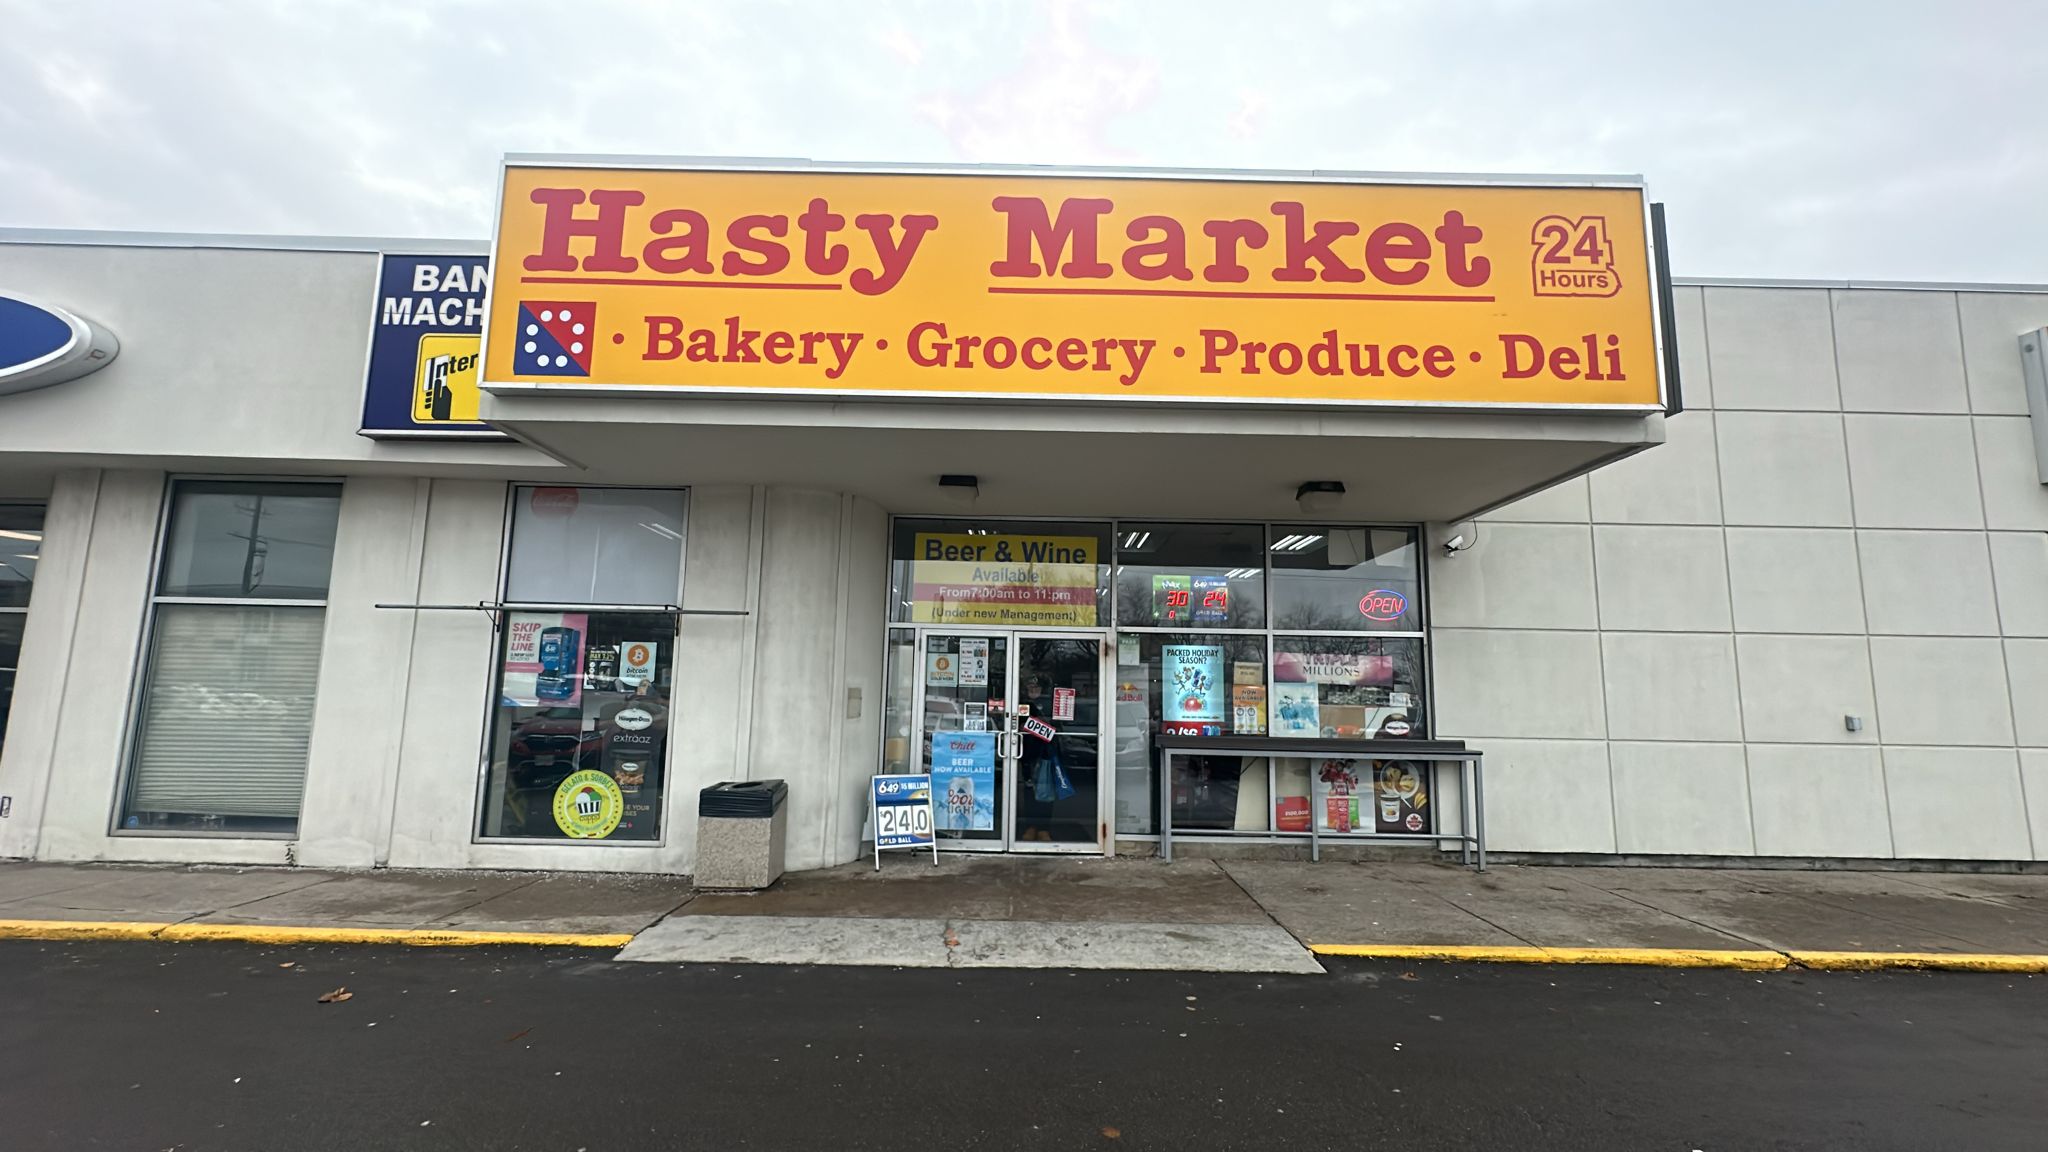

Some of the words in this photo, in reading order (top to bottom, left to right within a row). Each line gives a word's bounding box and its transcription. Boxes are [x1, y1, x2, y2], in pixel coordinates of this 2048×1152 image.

[523, 188, 938, 295] Hasty
[990, 197, 1491, 288] Market
[1541, 225, 1604, 264] 24
[1540, 269, 1609, 289] Hours
[642, 316, 863, 379] Bakery
[907, 321, 1156, 385] Grocery
[1199, 329, 1455, 378] Produce
[1499, 334, 1626, 381] Deli
[925, 539, 987, 561] Beer
[995, 541, 1012, 562] &
[1021, 541, 1087, 564] Wine
[972, 567, 1039, 583] Available
[1018, 588, 1031, 600] to
[1034, 588, 1071, 602] 11:pm
[1167, 590, 1188, 607] 30
[1203, 590, 1227, 607] 24
[1362, 597, 1403, 613] OPEN
[932, 607, 971, 619] (Under
[973, 610, 998, 618] new
[1000, 609, 1078, 622] Management)
[512, 622, 542, 633] SKIP
[512, 633, 533, 642] THE
[511, 643, 535, 652] LINE
[1166, 649, 1190, 657] PACKED
[1191, 649, 1219, 657] HOLIDAY
[1178, 657, 1208, 665] SEASON?
[1304, 653, 1359, 666] TRIPLE
[1302, 665, 1360, 677] MILLIONS
[1027, 719, 1053, 739] OPEN
[949, 741, 977, 752] Chill
[952, 758, 974, 766] BEER
[879, 781, 899, 793] 649
